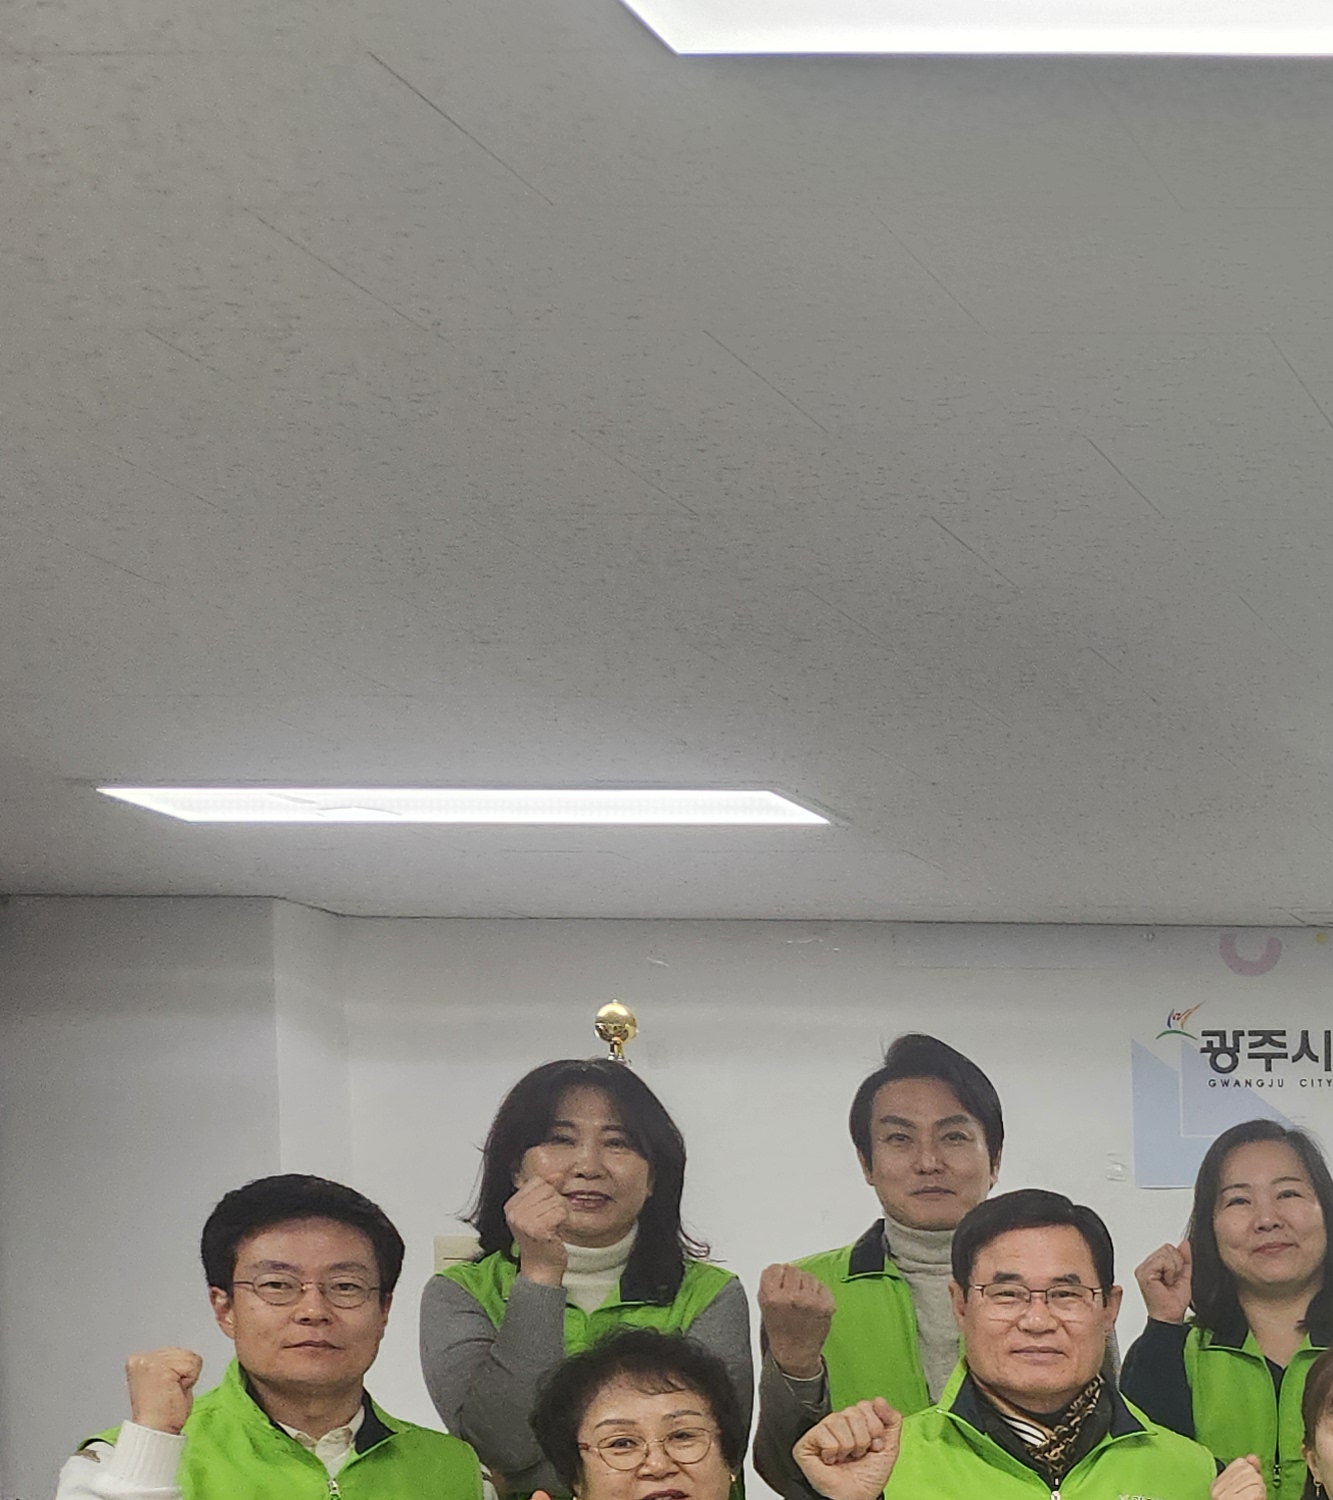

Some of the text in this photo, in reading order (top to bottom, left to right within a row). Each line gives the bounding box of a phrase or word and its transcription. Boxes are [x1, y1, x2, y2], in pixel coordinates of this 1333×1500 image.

[1200, 1029, 1332, 1074] 광주시
[1207, 1078, 1333, 1088] GWANGJU CITY
